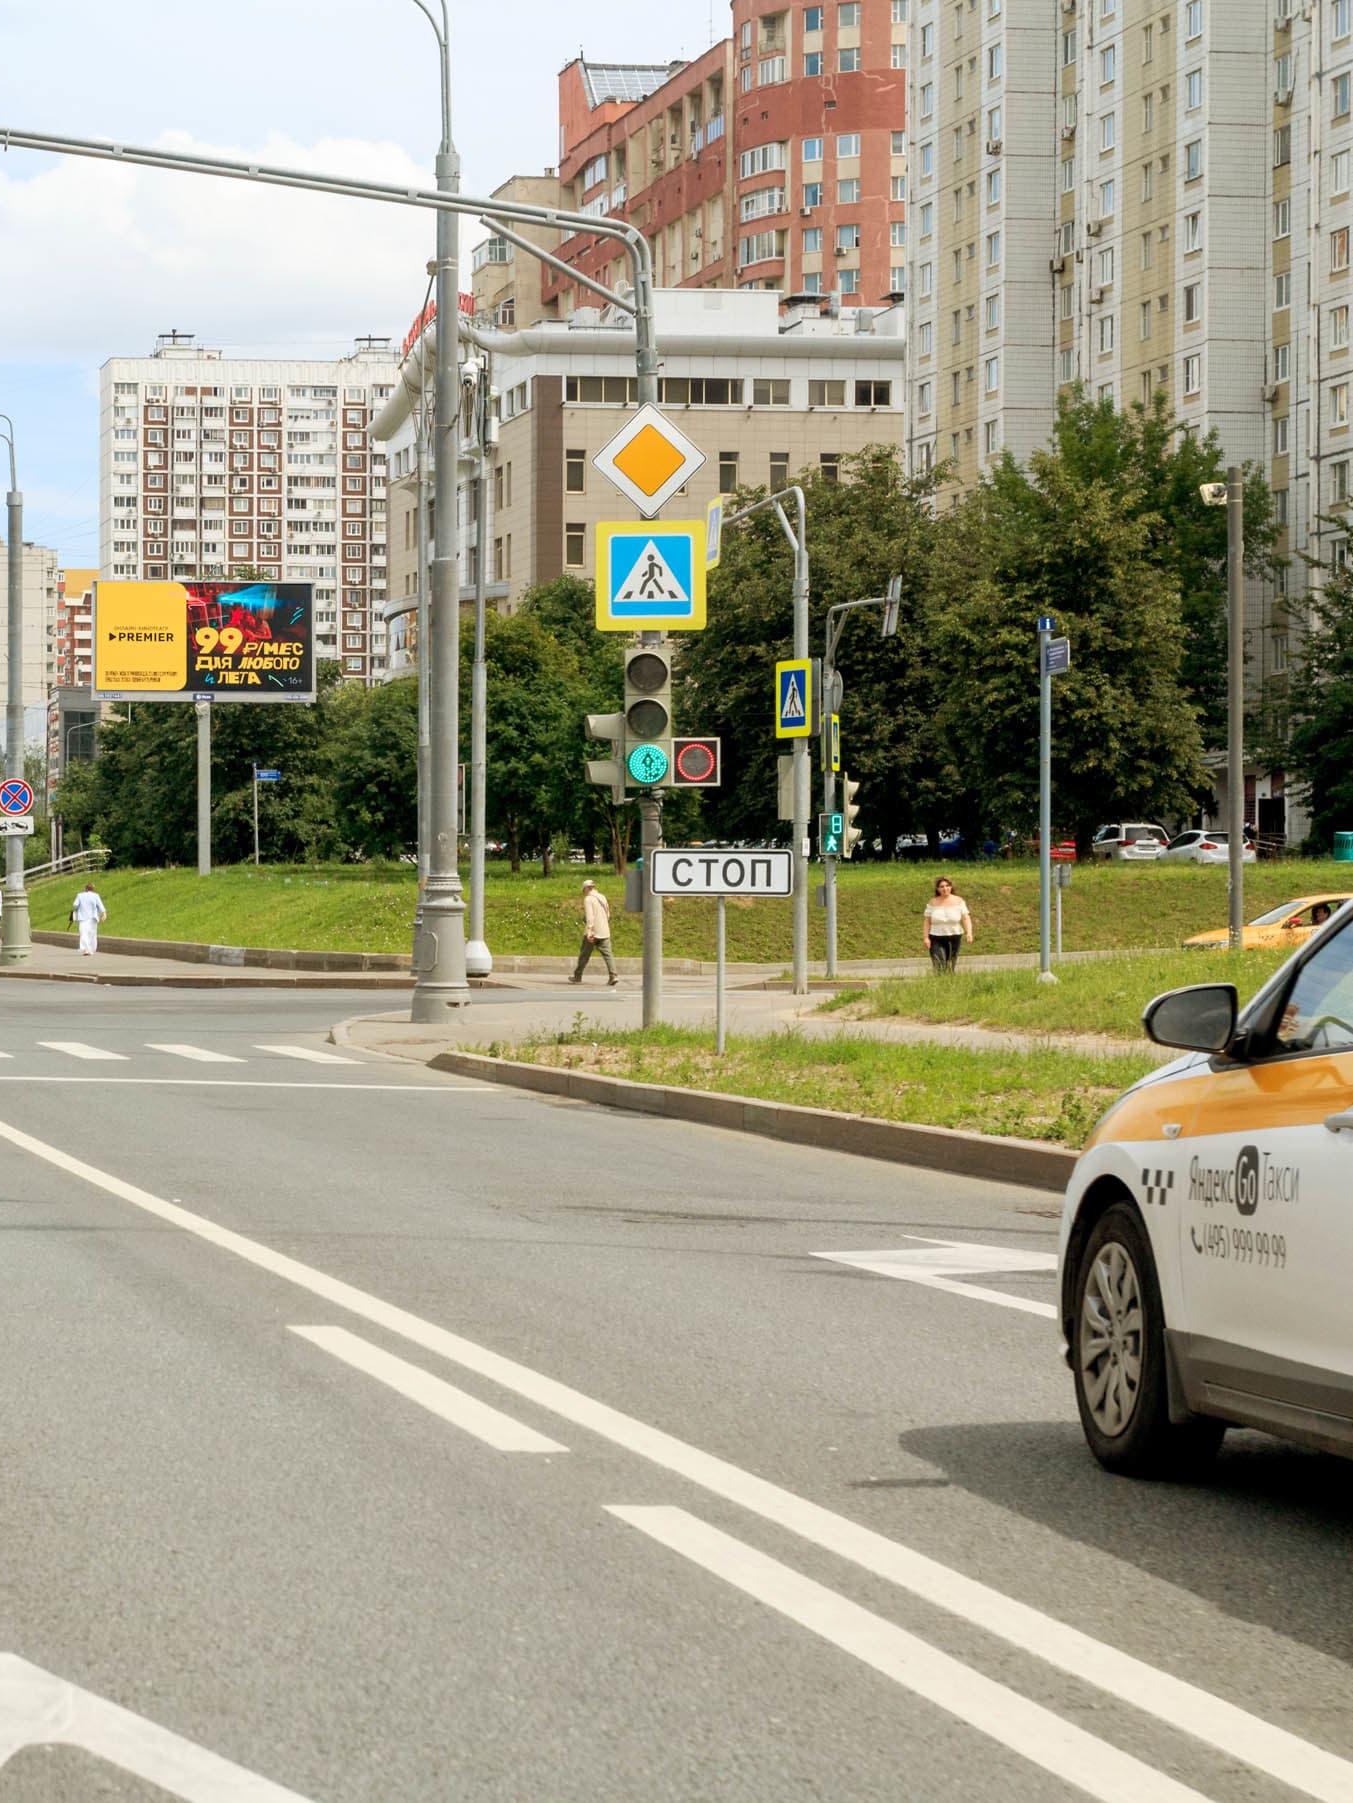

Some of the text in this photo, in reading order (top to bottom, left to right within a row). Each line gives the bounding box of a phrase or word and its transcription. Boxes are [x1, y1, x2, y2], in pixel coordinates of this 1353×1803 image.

[118, 632, 174, 642] PREMIER
[196, 627, 243, 654] 99
[195, 656, 300, 671] ДЛЯ ЛЮБОГО
[217, 671, 262, 685] ЛЕТА
[288, 676, 303, 685] 16+
[672, 858, 772, 887] СТОП
[1189, 1151, 1300, 1208] Яндекс Go Такси
[1203, 1223, 1287, 1270] (495) 999 99 99
